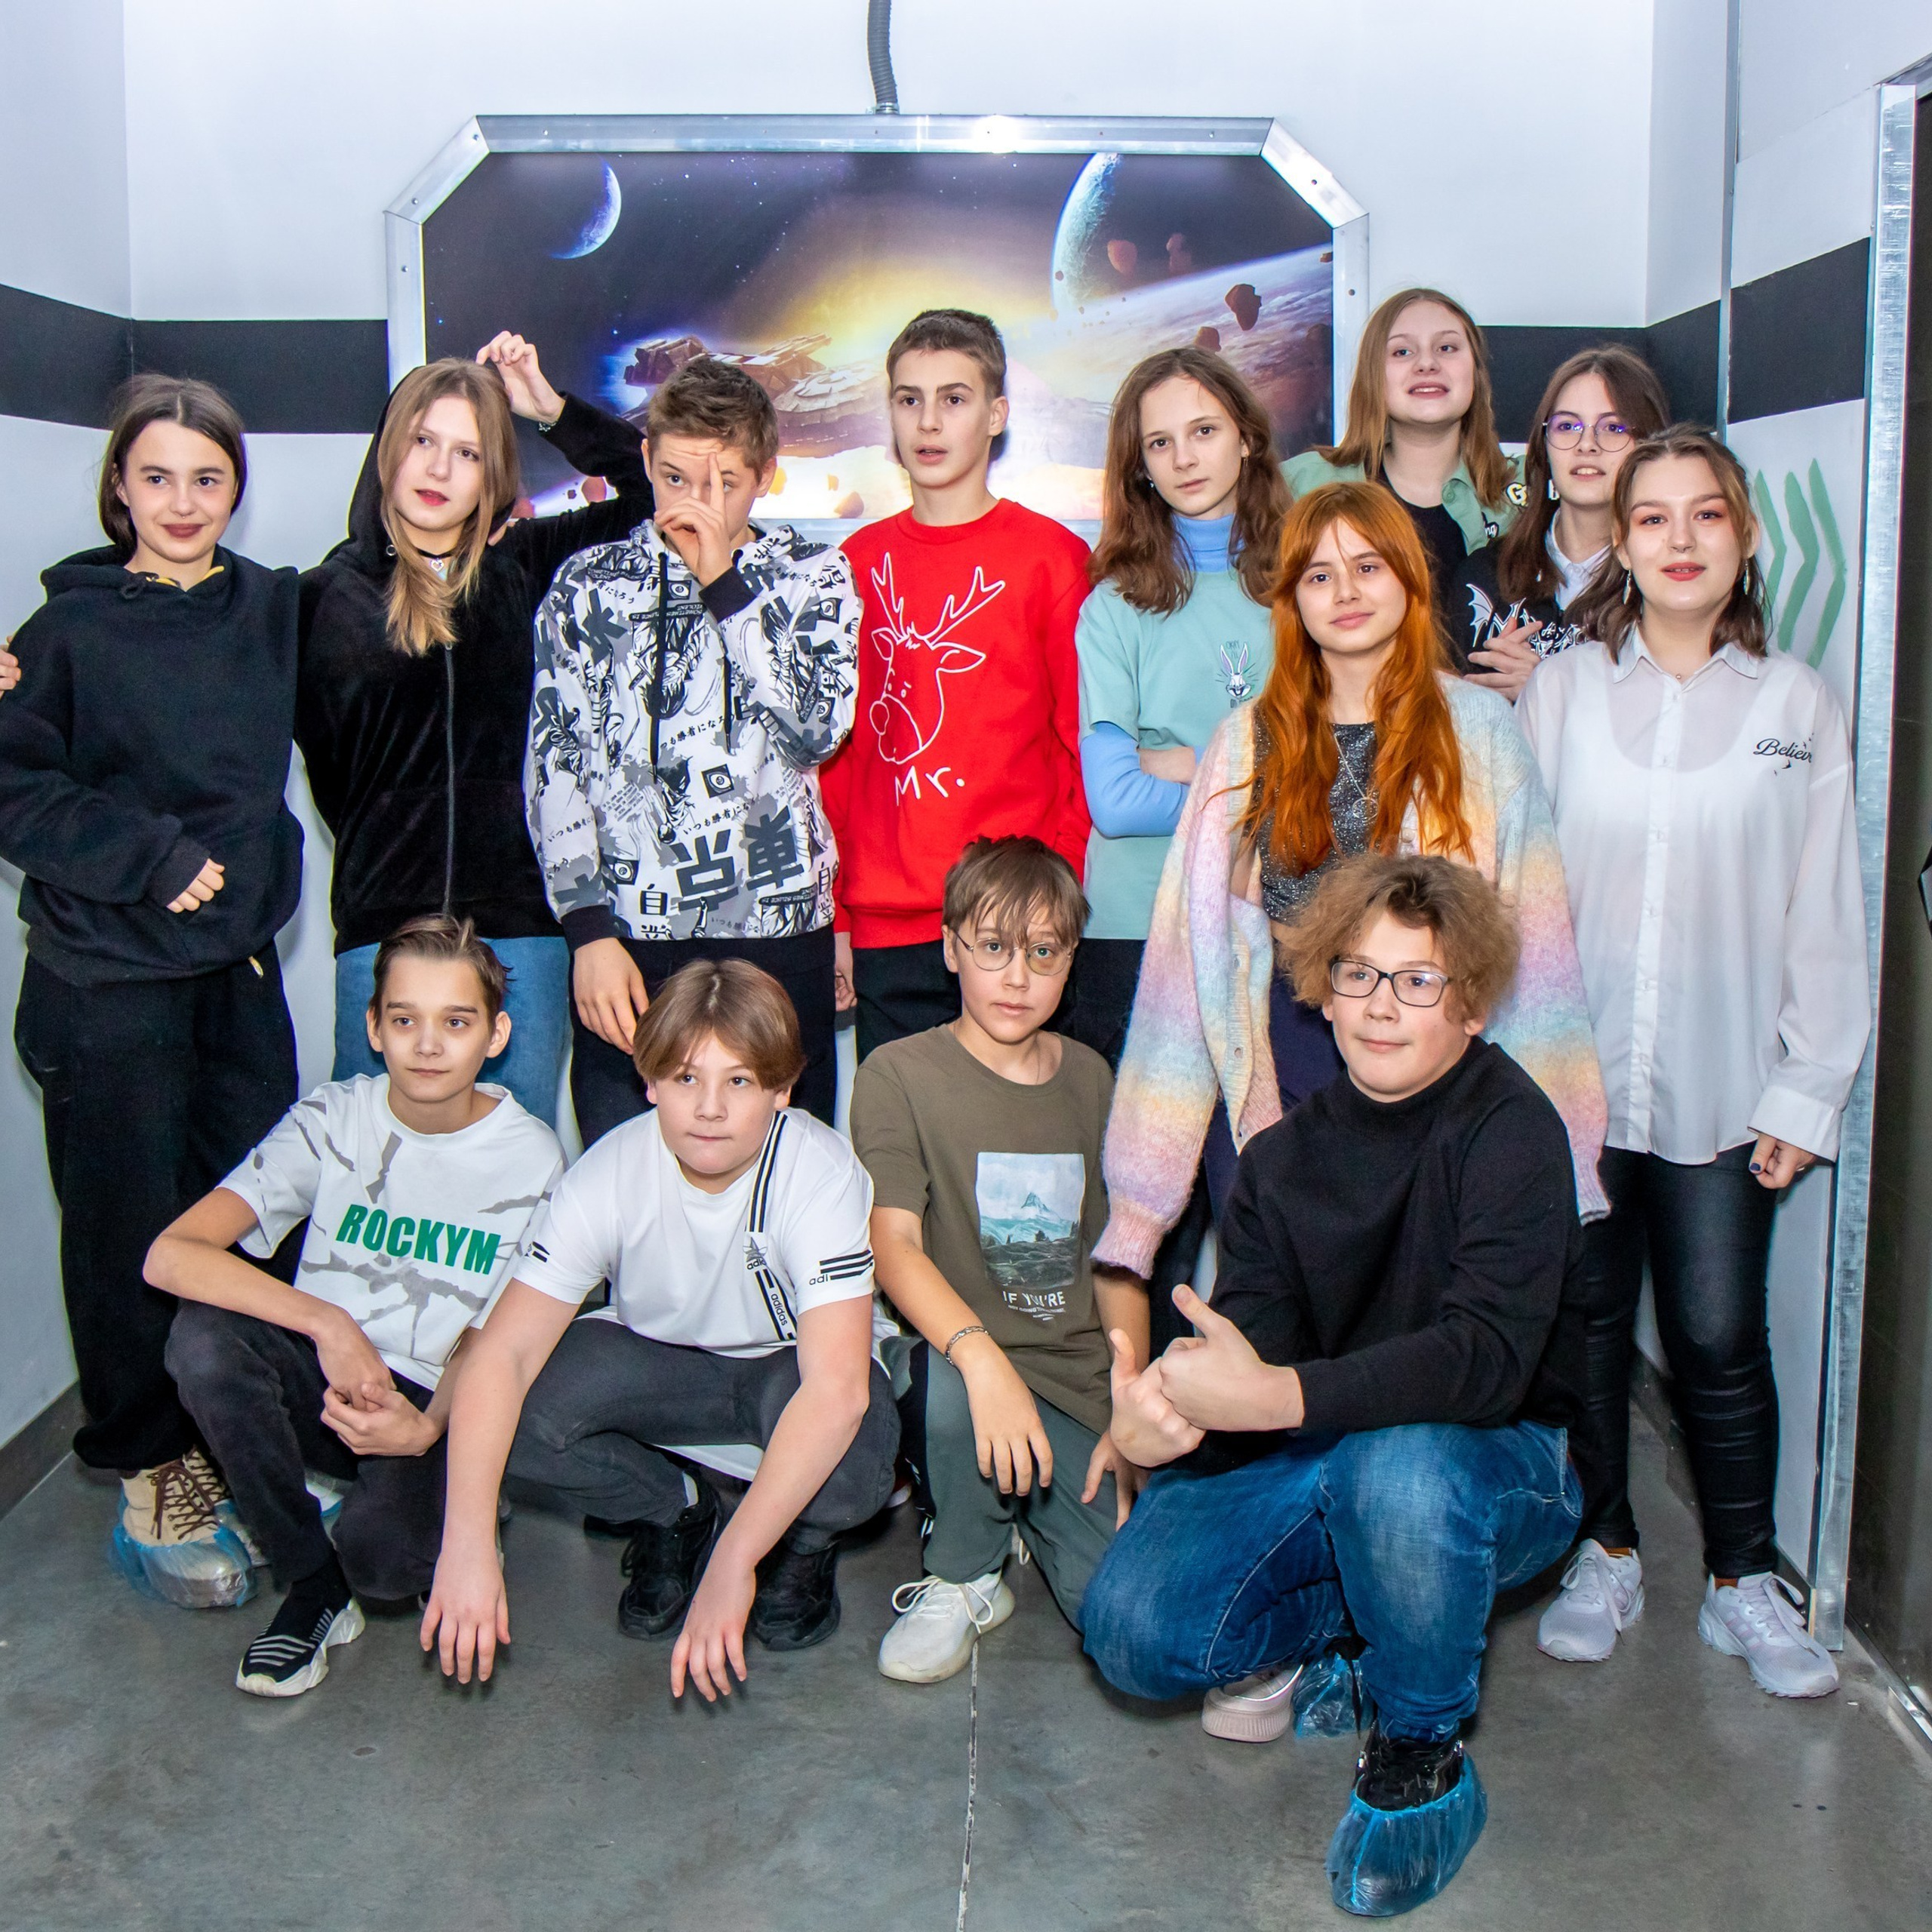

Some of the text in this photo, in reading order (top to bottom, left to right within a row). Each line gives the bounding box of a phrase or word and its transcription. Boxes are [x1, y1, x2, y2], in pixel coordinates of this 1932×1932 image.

[895, 765, 965, 807] Mr.
[335, 1204, 502, 1275] ROCKYM
[771, 1294, 788, 1326] adidas
[1002, 1291, 1017, 1303] IF
